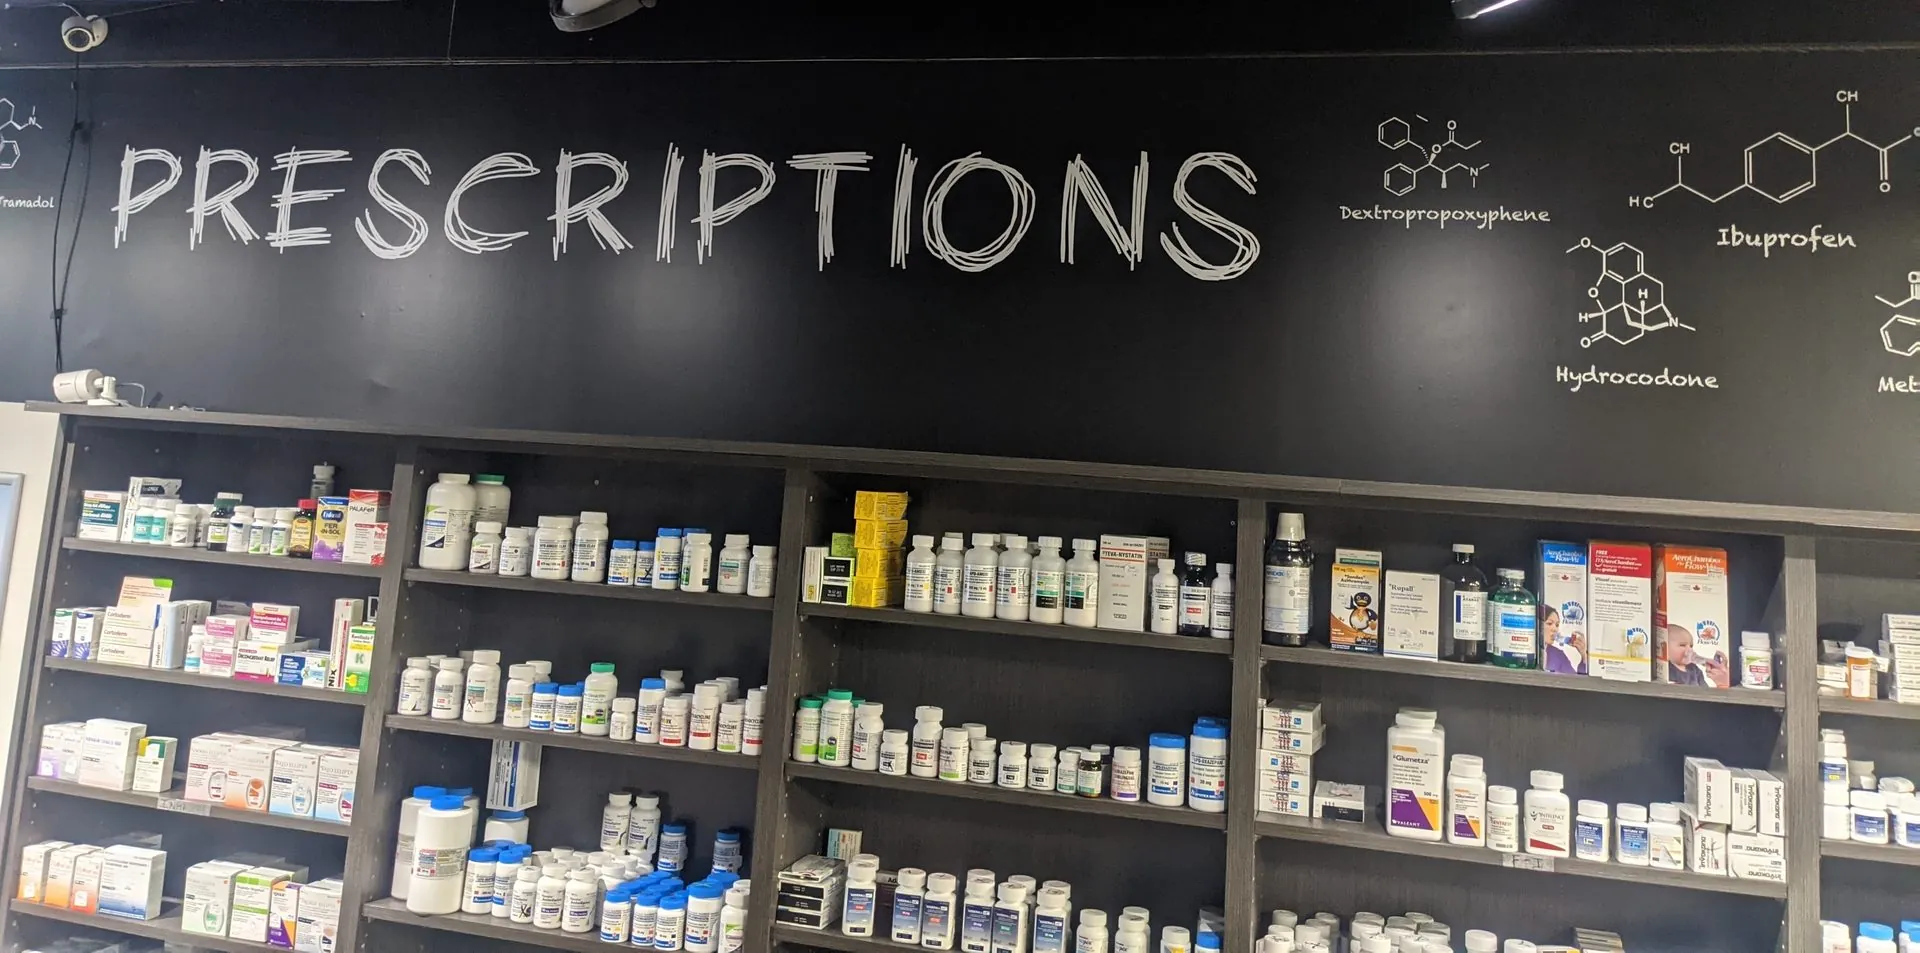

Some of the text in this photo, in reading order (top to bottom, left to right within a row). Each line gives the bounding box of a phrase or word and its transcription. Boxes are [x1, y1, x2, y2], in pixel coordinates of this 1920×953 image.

[111, 142, 1260, 283] PRESCRIPTIONS
[1339, 204, 1551, 230] Dextropropoxyphene
[1716, 224, 1857, 258] Ibuprofen
[1556, 364, 1720, 393] Hydrocodone
